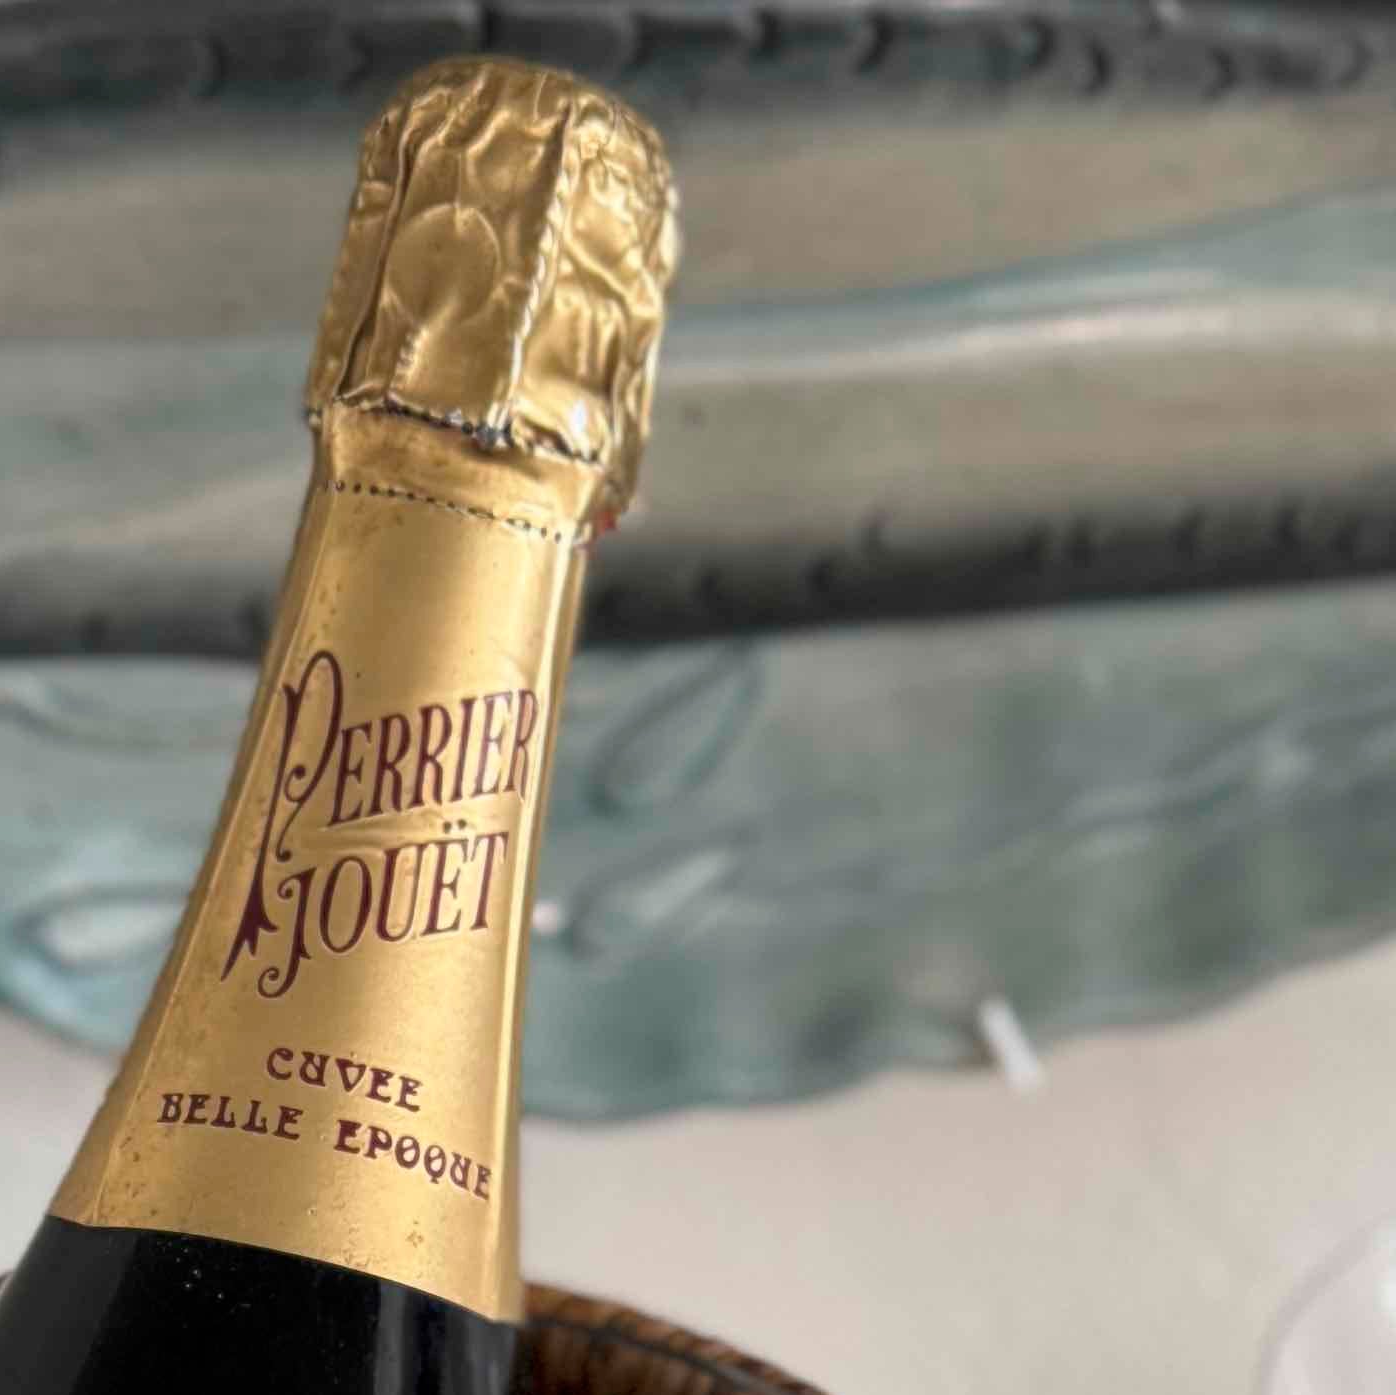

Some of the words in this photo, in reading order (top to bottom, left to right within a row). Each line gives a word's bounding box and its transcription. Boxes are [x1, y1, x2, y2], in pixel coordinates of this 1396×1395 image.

[221, 650, 539, 982] PERRIER
[258, 818, 510, 998] JOUËT
[157, 1092, 304, 1140] BELLE
[334, 1119, 493, 1200] EPOQUE
[266, 1047, 423, 1112] CUVEE
